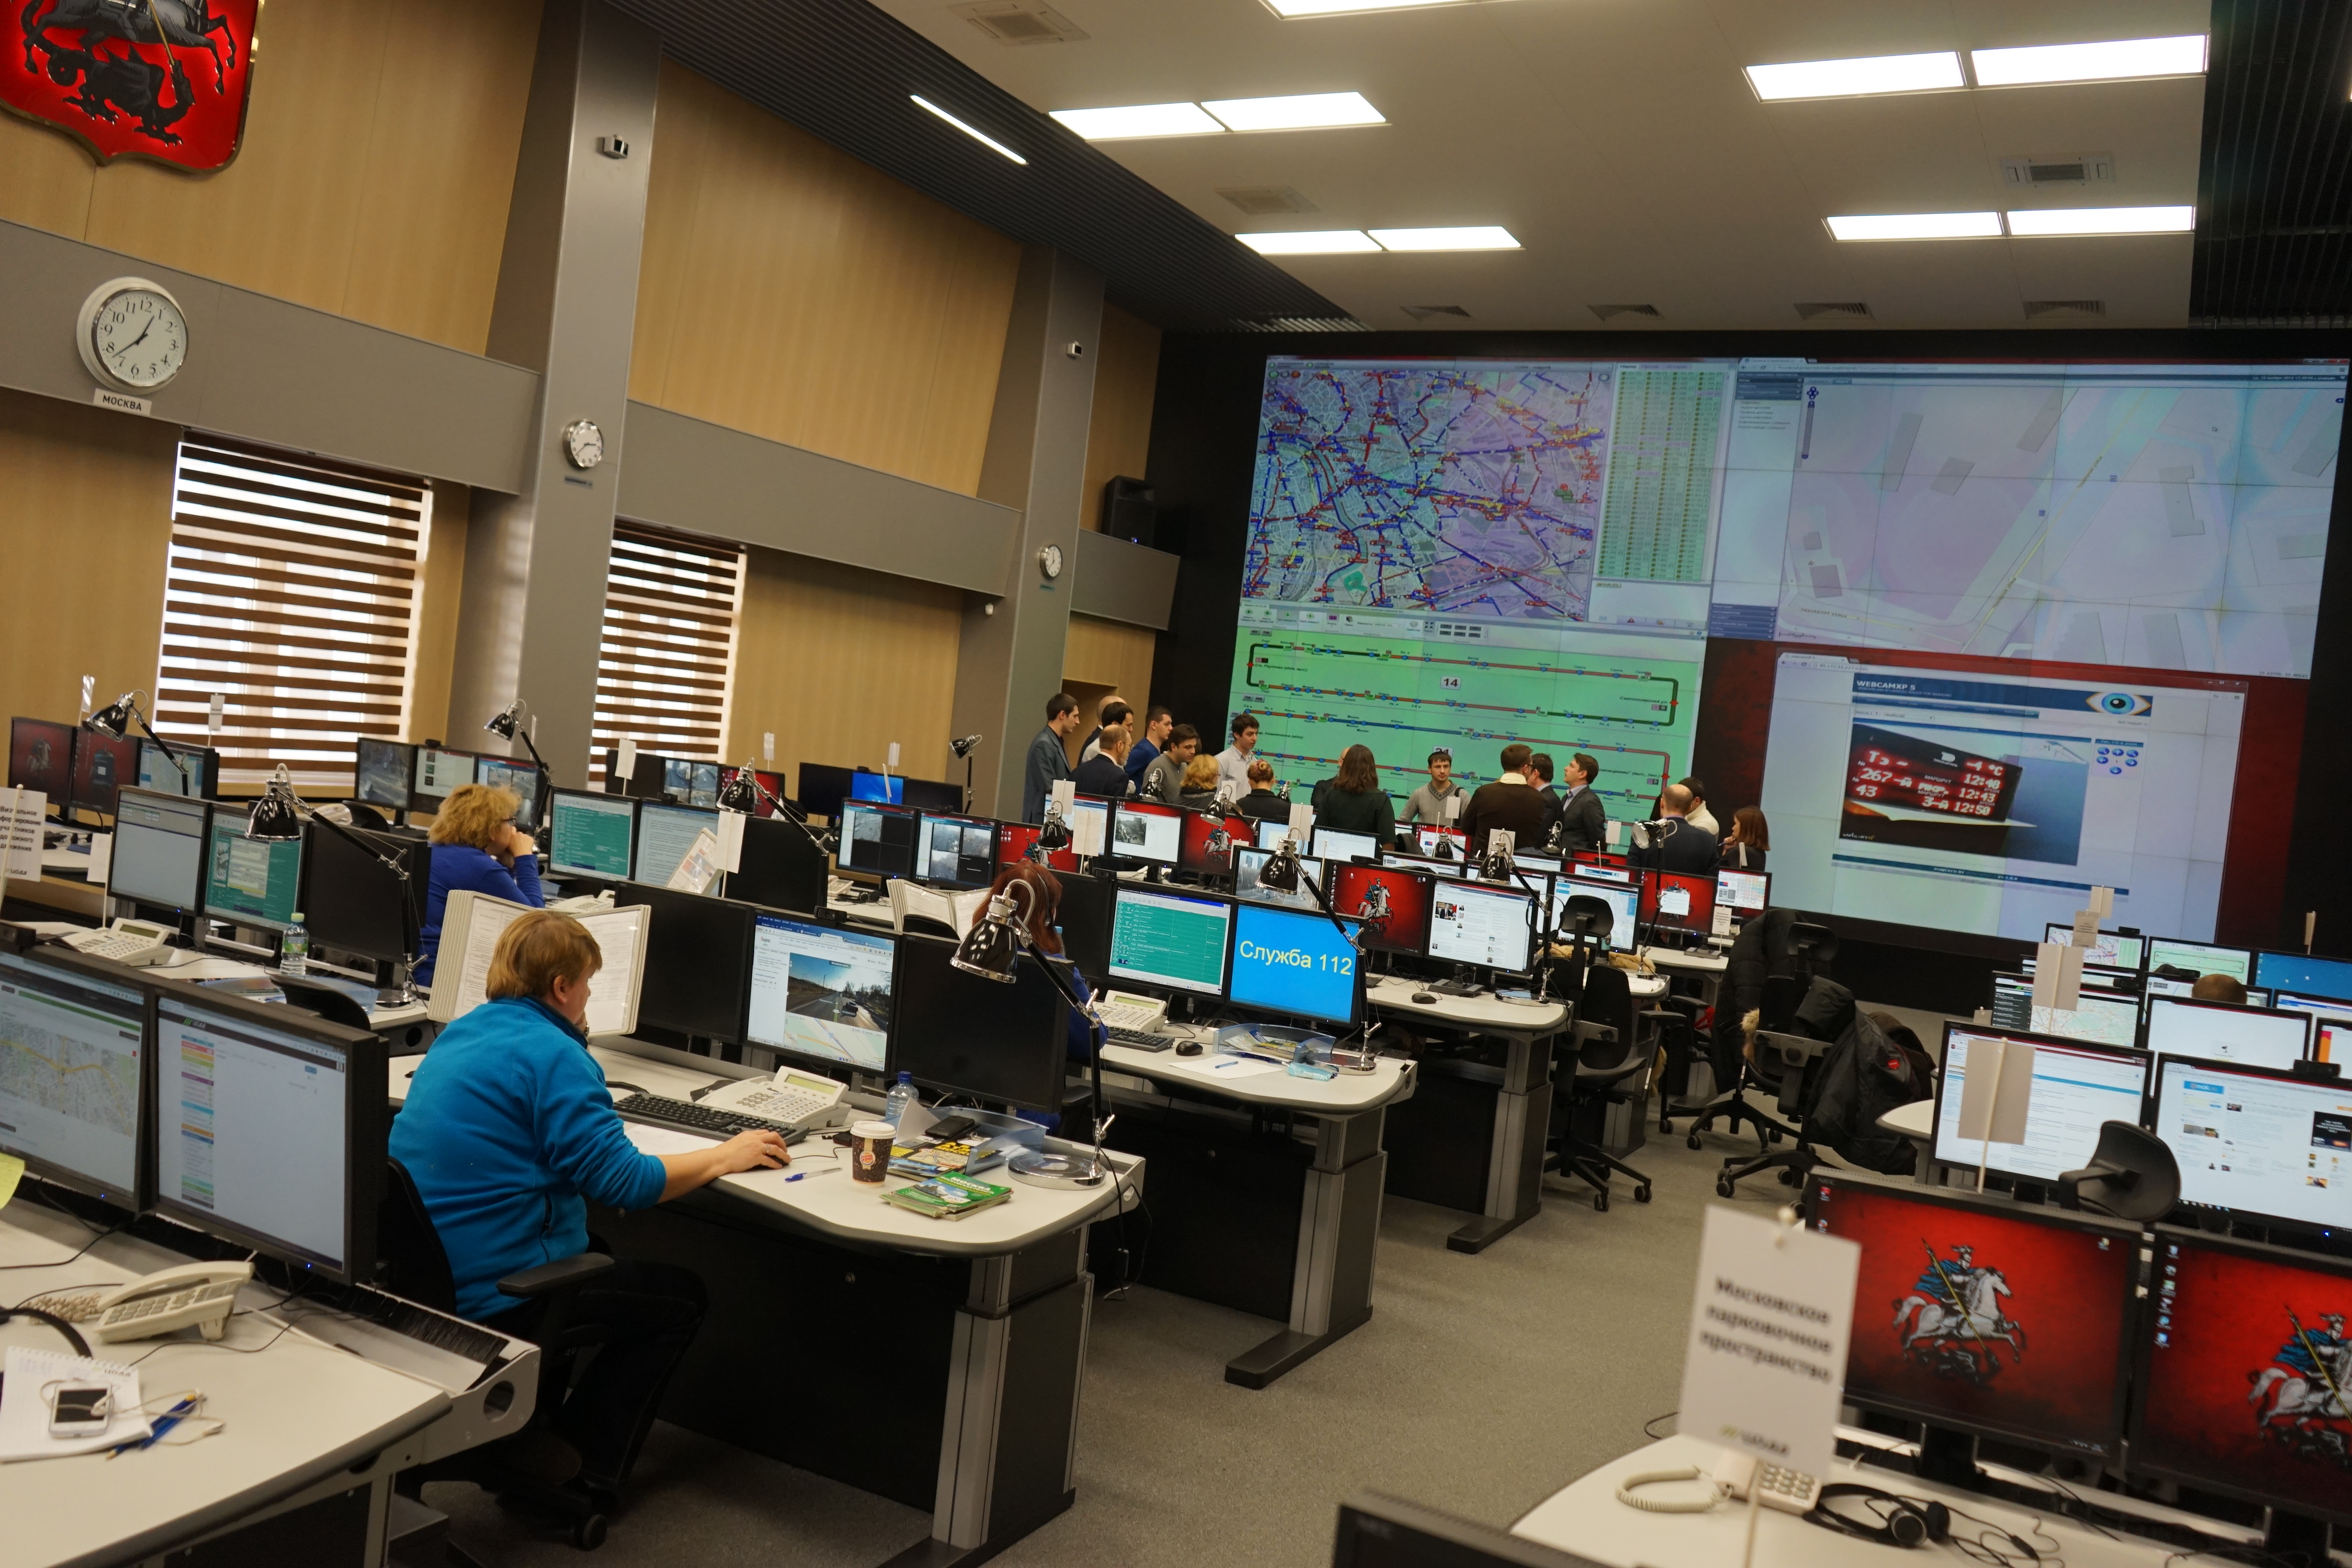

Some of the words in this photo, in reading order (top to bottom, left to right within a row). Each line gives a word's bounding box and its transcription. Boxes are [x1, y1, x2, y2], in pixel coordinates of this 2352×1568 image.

[125, 301, 136, 314] 11
[140, 300, 152, 313] 12
[112, 311, 125, 324] 10
[158, 310, 163, 320] 1
[105, 324, 113, 336] 9
[166, 321, 173, 333] 2
[106, 342, 114, 353] 8
[169, 339, 177, 351] 3
[119, 356, 125, 367] 7
[161, 354, 170, 367] 4
[130, 364, 139, 375] 6
[149, 363, 157, 375] 5
[103, 395, 142, 411] МОСКВА
[1444, 678, 1458, 687] 14
[1857, 680, 1908, 690] WEBCAMXP
[1860, 768, 1893, 783] 267
[1924, 774, 1952, 784] МАРШРУТ
[1856, 784, 1878, 797] 43
[1, 807, 37, 816] Визальное
[0, 835, 33, 843] доожного
[1240, 940, 1312, 969] Служба
[1319, 954, 1352, 975] 112
[1716, 1277, 1830, 1325] Московское
[1706, 1305, 1832, 1355] парковочное
[1701, 1331, 1832, 1383] пространство
